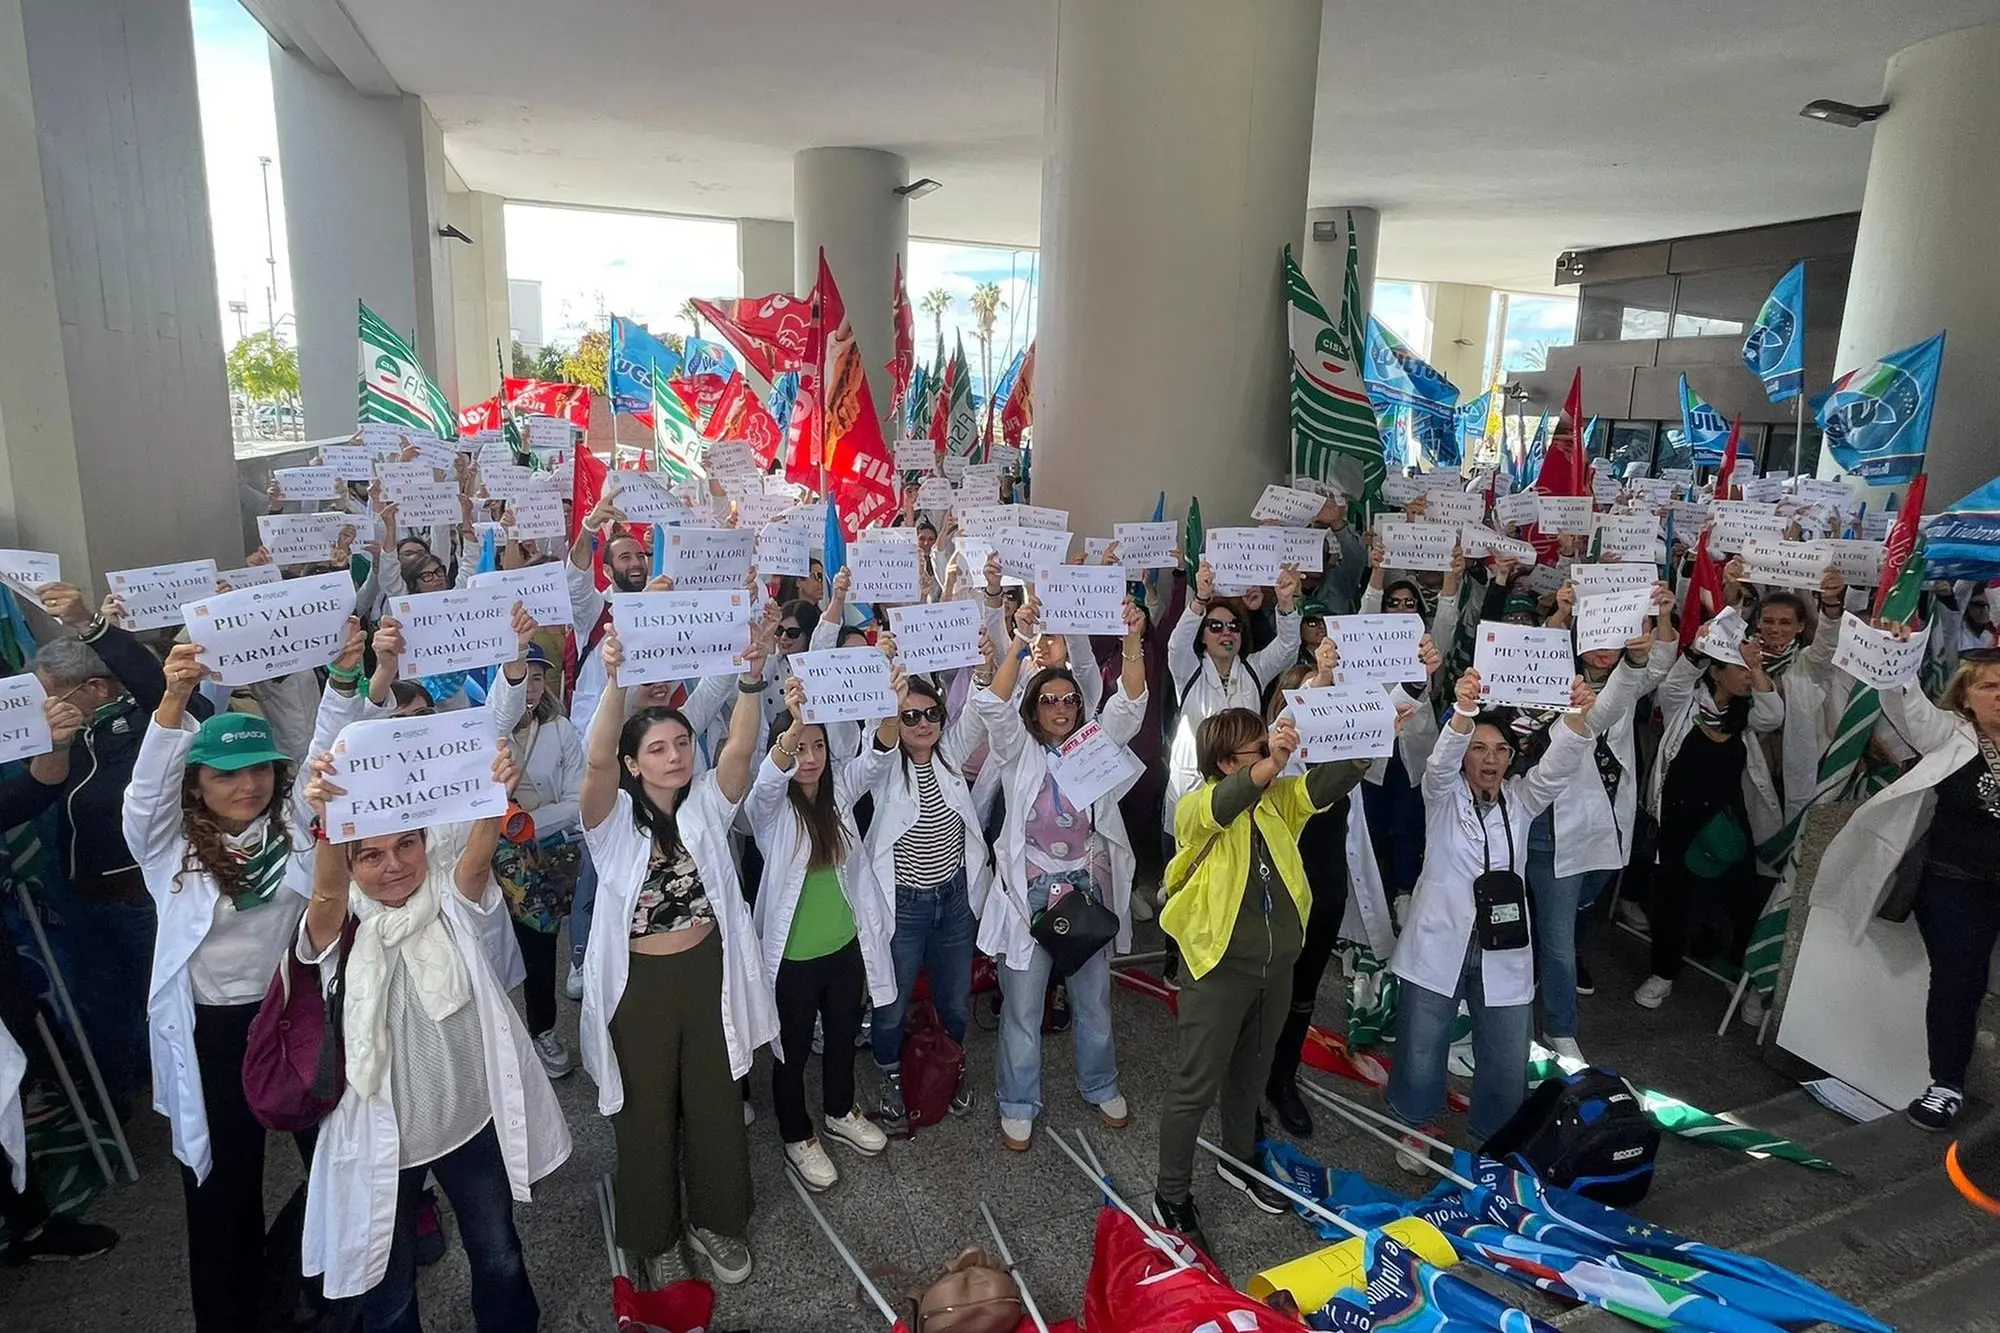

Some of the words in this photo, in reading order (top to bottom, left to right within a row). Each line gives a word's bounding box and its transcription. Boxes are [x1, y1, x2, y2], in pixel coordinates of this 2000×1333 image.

[1322, 338, 1346, 356] CISL
[1143, 534, 1172, 543] VALORE
[1412, 534, 1448, 542] VALORE
[1022, 540, 1058, 552] VALORE
[1238, 542, 1276, 552] VALORE
[706, 548, 748, 558] VALORE
[1020, 551, 1032, 559] AI
[1121, 550, 1170, 560] FARMACISTI
[1390, 552, 1445, 560] FARMACISTI
[1778, 550, 1822, 562] VALORE
[705, 563, 718, 571] AI
[879, 560, 916, 568] VALORE
[998, 558, 1036, 570] FARMAC
[1215, 562, 1275, 572] FARMACISTI
[1750, 564, 1816, 579] FARMACISTI
[158, 576, 211, 590] VALORE
[675, 574, 742, 586] FARMACISTI
[1606, 575, 1650, 584] VALORE
[515, 582, 559, 596] ALORE
[856, 582, 913, 591] FARMACISTI
[1072, 584, 1118, 594] VALORE
[162, 592, 177, 600] AI
[1074, 598, 1086, 606] AI
[130, 602, 182, 616] FARMA
[214, 612, 255, 632] PIU'
[260, 598, 342, 622] VALORE
[448, 607, 504, 623] VALORE
[1046, 610, 1115, 620] FARMACISTI
[1602, 602, 1640, 616] VALORE
[634, 612, 735, 627] FARMACISTI
[928, 616, 974, 630] VALORE
[1602, 616, 1611, 624] AI
[269, 626, 290, 640] AI
[452, 628, 466, 638] AI
[678, 630, 694, 642] AI
[1368, 630, 1416, 641] VALORE
[1580, 625, 1635, 638] FARMACISTI
[932, 634, 944, 643] AI
[218, 632, 340, 668] FARMACISTI
[414, 638, 504, 659] FARMACISTI
[630, 644, 700, 660] VALORE
[903, 642, 972, 660] FARMACISTI
[1370, 645, 1384, 654] AI
[1882, 638, 1927, 656] VAL
[1522, 648, 1571, 660] VALORE
[834, 663, 884, 674] VALORE
[1342, 656, 1414, 670] FARMACISTI
[1524, 662, 1539, 672] AI
[1849, 652, 1918, 676] FARMAC
[841, 680, 854, 690] AI
[1490, 673, 1571, 686] FARMACISTI
[0, 695, 33, 712] ORE
[812, 691, 885, 706] FARMACISTI
[1335, 700, 1386, 715] VALORE
[1342, 718, 1356, 730] AI
[1308, 728, 1384, 746] FARMACISTI
[349, 754, 392, 774] PIU'
[398, 738, 483, 764] VALORE
[405, 768, 426, 786] AI
[350, 778, 481, 816] FARMACISTI
